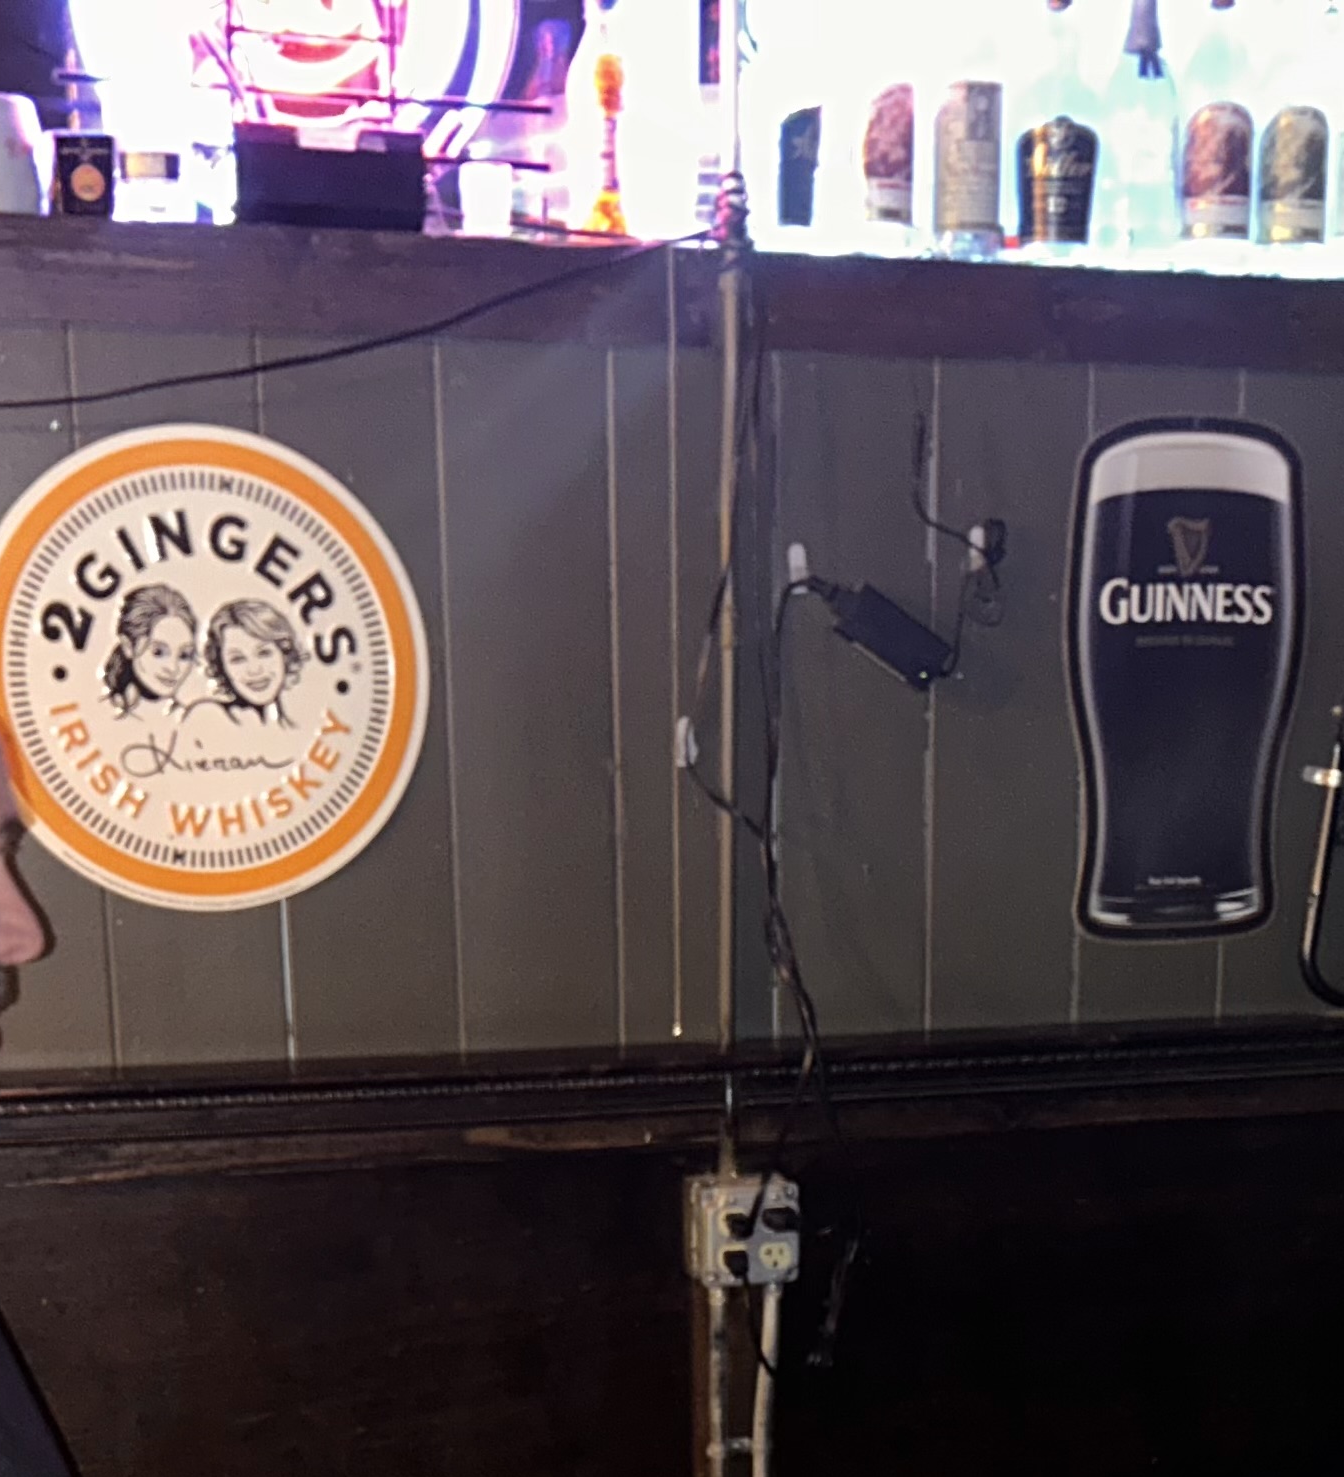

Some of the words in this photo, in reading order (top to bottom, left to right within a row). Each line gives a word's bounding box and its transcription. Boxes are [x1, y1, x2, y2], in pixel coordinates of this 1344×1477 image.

[1099, 577, 1273, 625] GUINNESS
[49, 702, 149, 818] IRISH
[169, 708, 354, 838] WHISKEY
